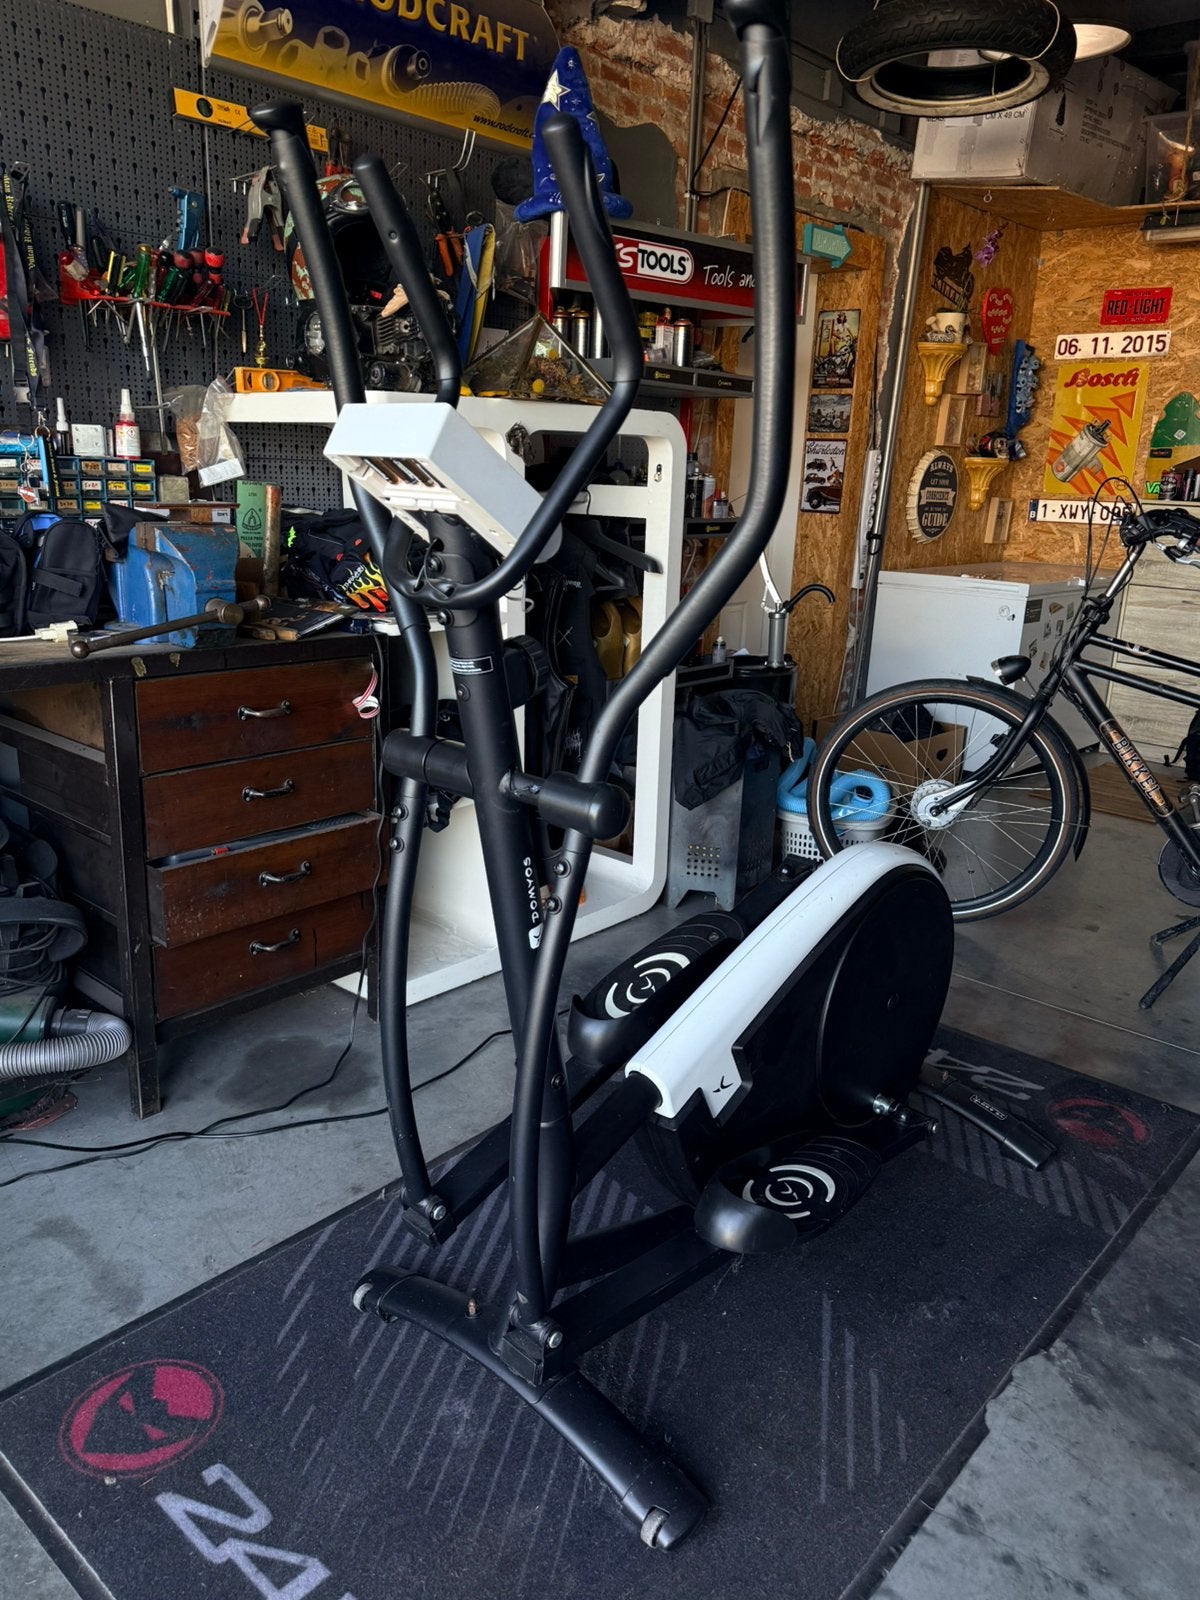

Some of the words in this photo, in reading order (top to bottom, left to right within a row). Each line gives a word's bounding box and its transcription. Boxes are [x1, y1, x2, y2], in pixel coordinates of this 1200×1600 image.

[359, 0, 530, 61] DCRAFT
[638, 248, 687, 276] TOOLS
[703, 264, 736, 288] Tools
[1121, 334, 1167, 354] 2015
[1064, 367, 1140, 388] Bosch
[930, 461, 954, 473] ALWAYS
[921, 512, 949, 527] GUIDE
[1112, 737, 1160, 799] BIKKEL
[523, 857, 539, 923] DOMYOS
